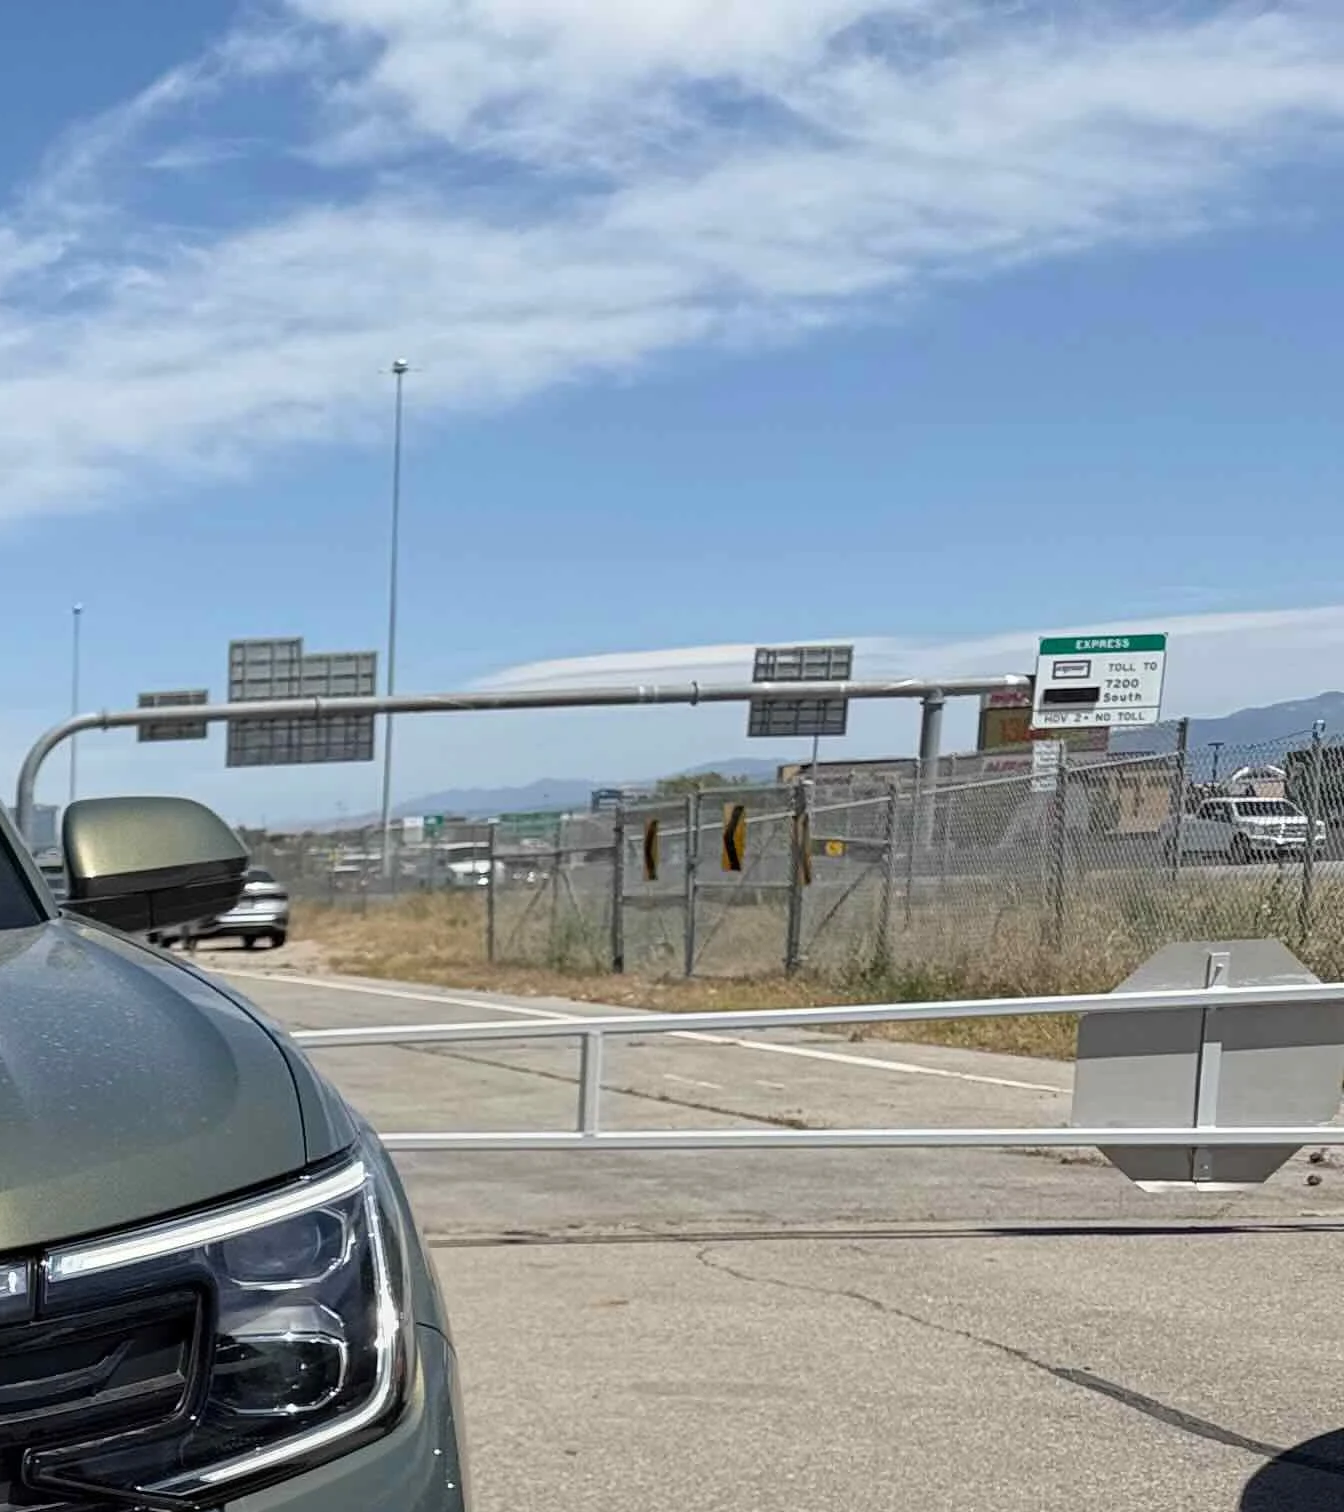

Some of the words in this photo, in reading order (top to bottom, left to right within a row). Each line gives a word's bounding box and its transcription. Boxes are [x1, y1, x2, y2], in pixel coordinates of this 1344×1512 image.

[1075, 638, 1130, 650] EXPRESS
[1108, 663, 1137, 672] TOLL
[1144, 662, 1158, 672] TO
[1105, 679, 1139, 689] 7200
[1103, 692, 1142, 703] South
[1044, 713, 1068, 723] HOV
[1096, 713, 1112, 722] NO
[1118, 712, 1145, 721] TOLL
